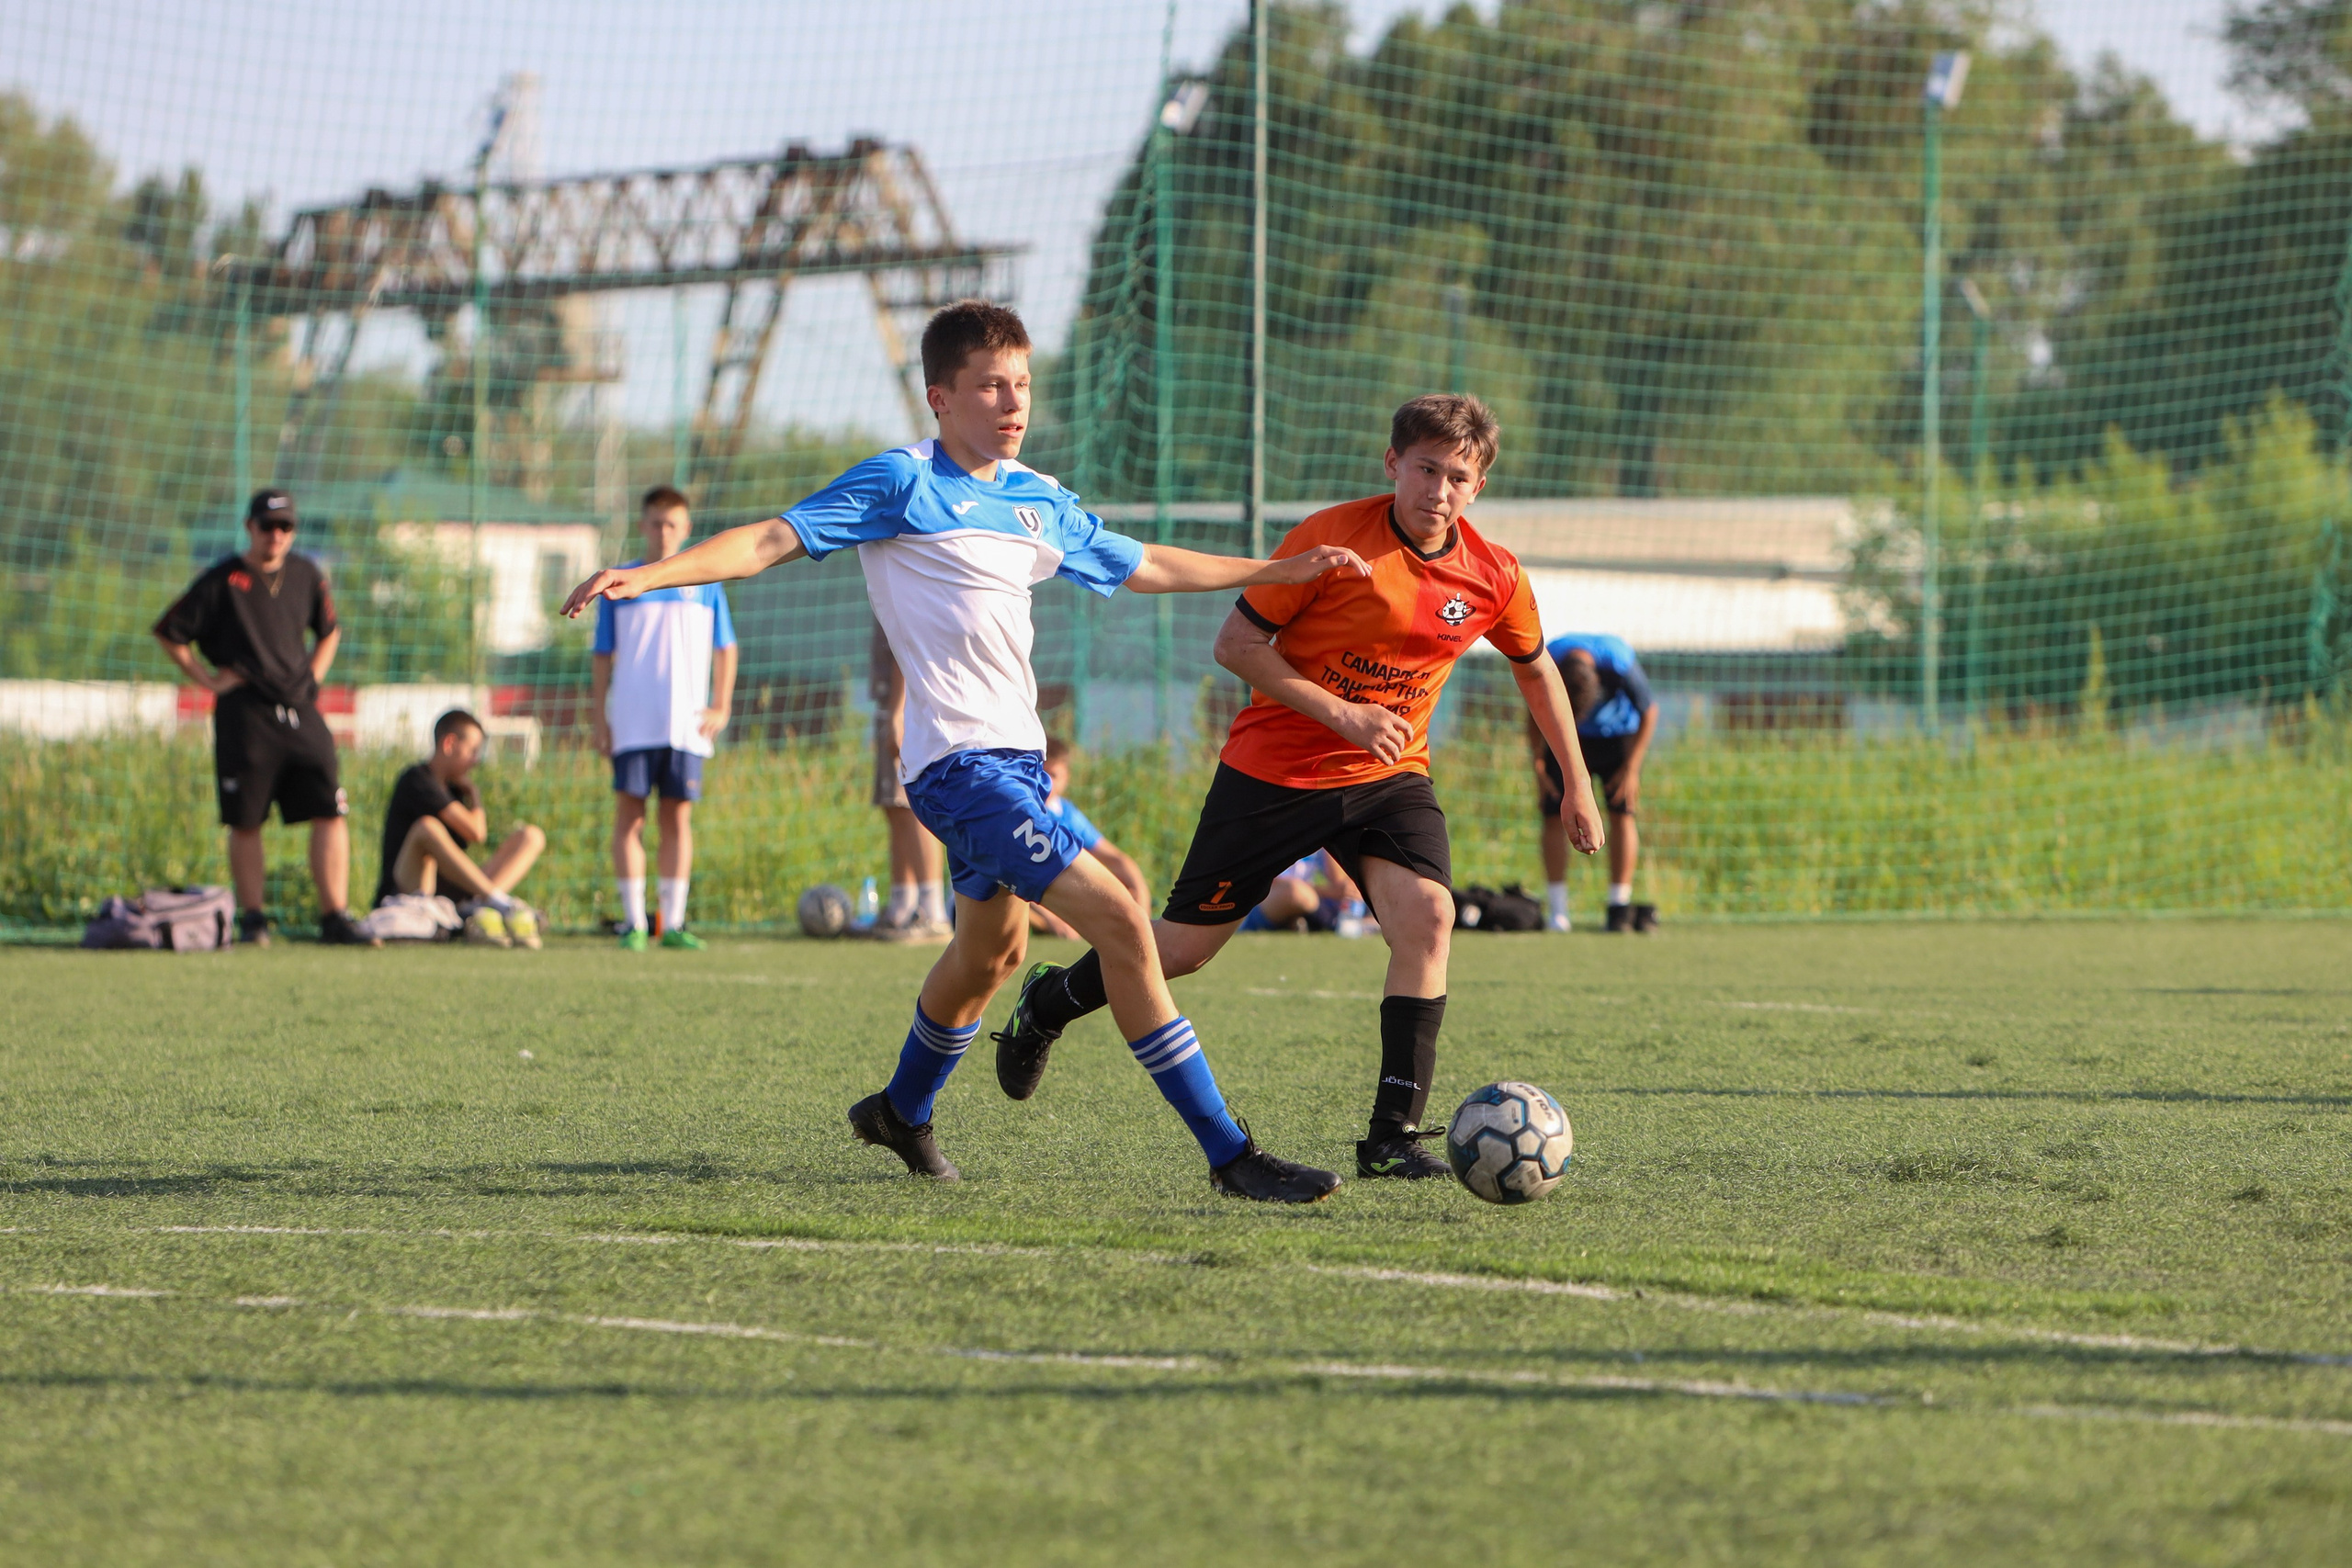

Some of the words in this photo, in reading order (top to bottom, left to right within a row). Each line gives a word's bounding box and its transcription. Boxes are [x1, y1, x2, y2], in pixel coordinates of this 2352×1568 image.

[1436, 632, 1463, 643] KINEL
[1012, 818, 1052, 863] 3
[1210, 881, 1232, 904] 7
[1381, 1075, 1421, 1090] JÖGEL
